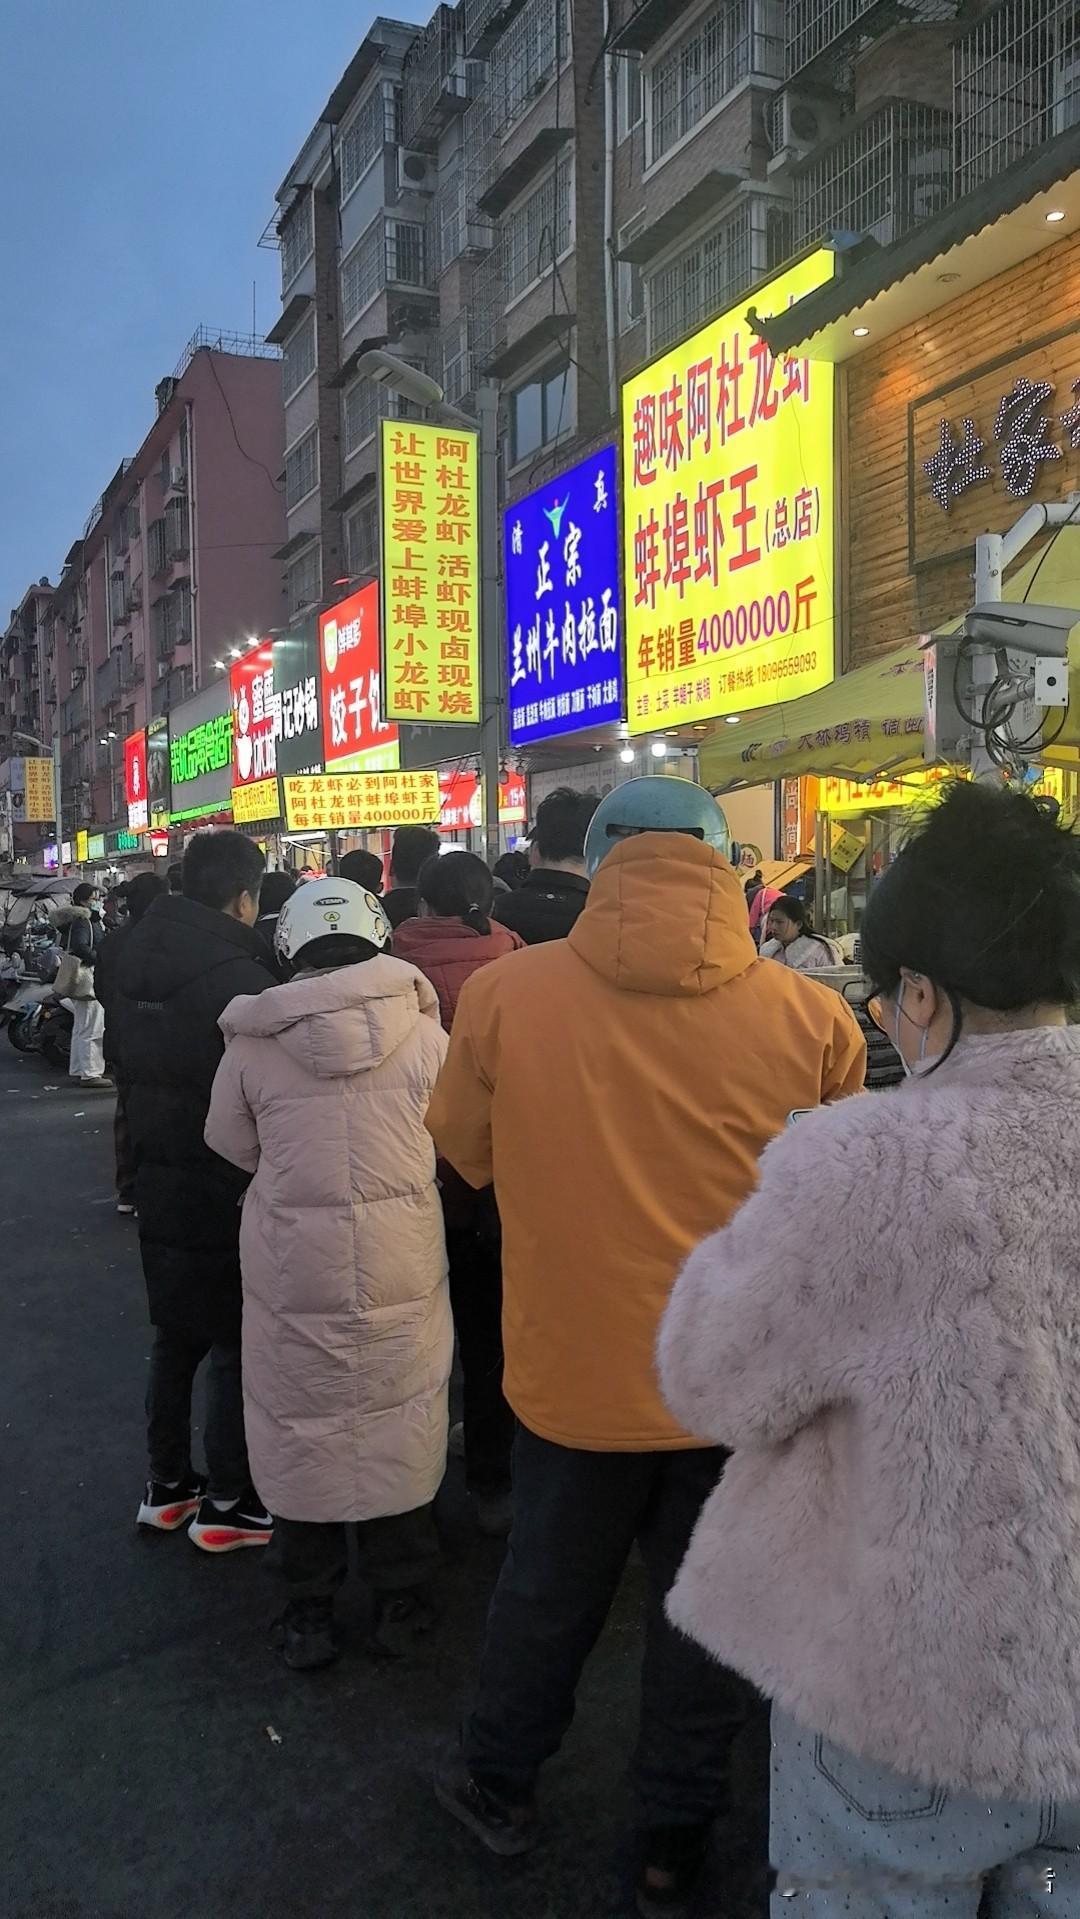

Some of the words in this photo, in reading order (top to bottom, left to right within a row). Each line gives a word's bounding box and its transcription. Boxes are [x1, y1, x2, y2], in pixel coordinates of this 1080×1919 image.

[512, 519, 523, 554] 清
[593, 470, 608, 512] 真
[390, 431, 429, 713] 让世界爱上蚌埠小龙虾
[535, 522, 582, 600] 正宗
[511, 588, 618, 687] 兰州牛肉拉面
[637, 575, 818, 678] 年销量4000000斤
[252, 668, 275, 723] 蜜雪
[273, 677, 318, 742] 周记砂锅
[289, 774, 434, 793] 吃龙虾必到阿杜家
[291, 791, 435, 811] 阿杜龙虾蚌埠虾王
[293, 808, 436, 827] 每年销量400000斤
